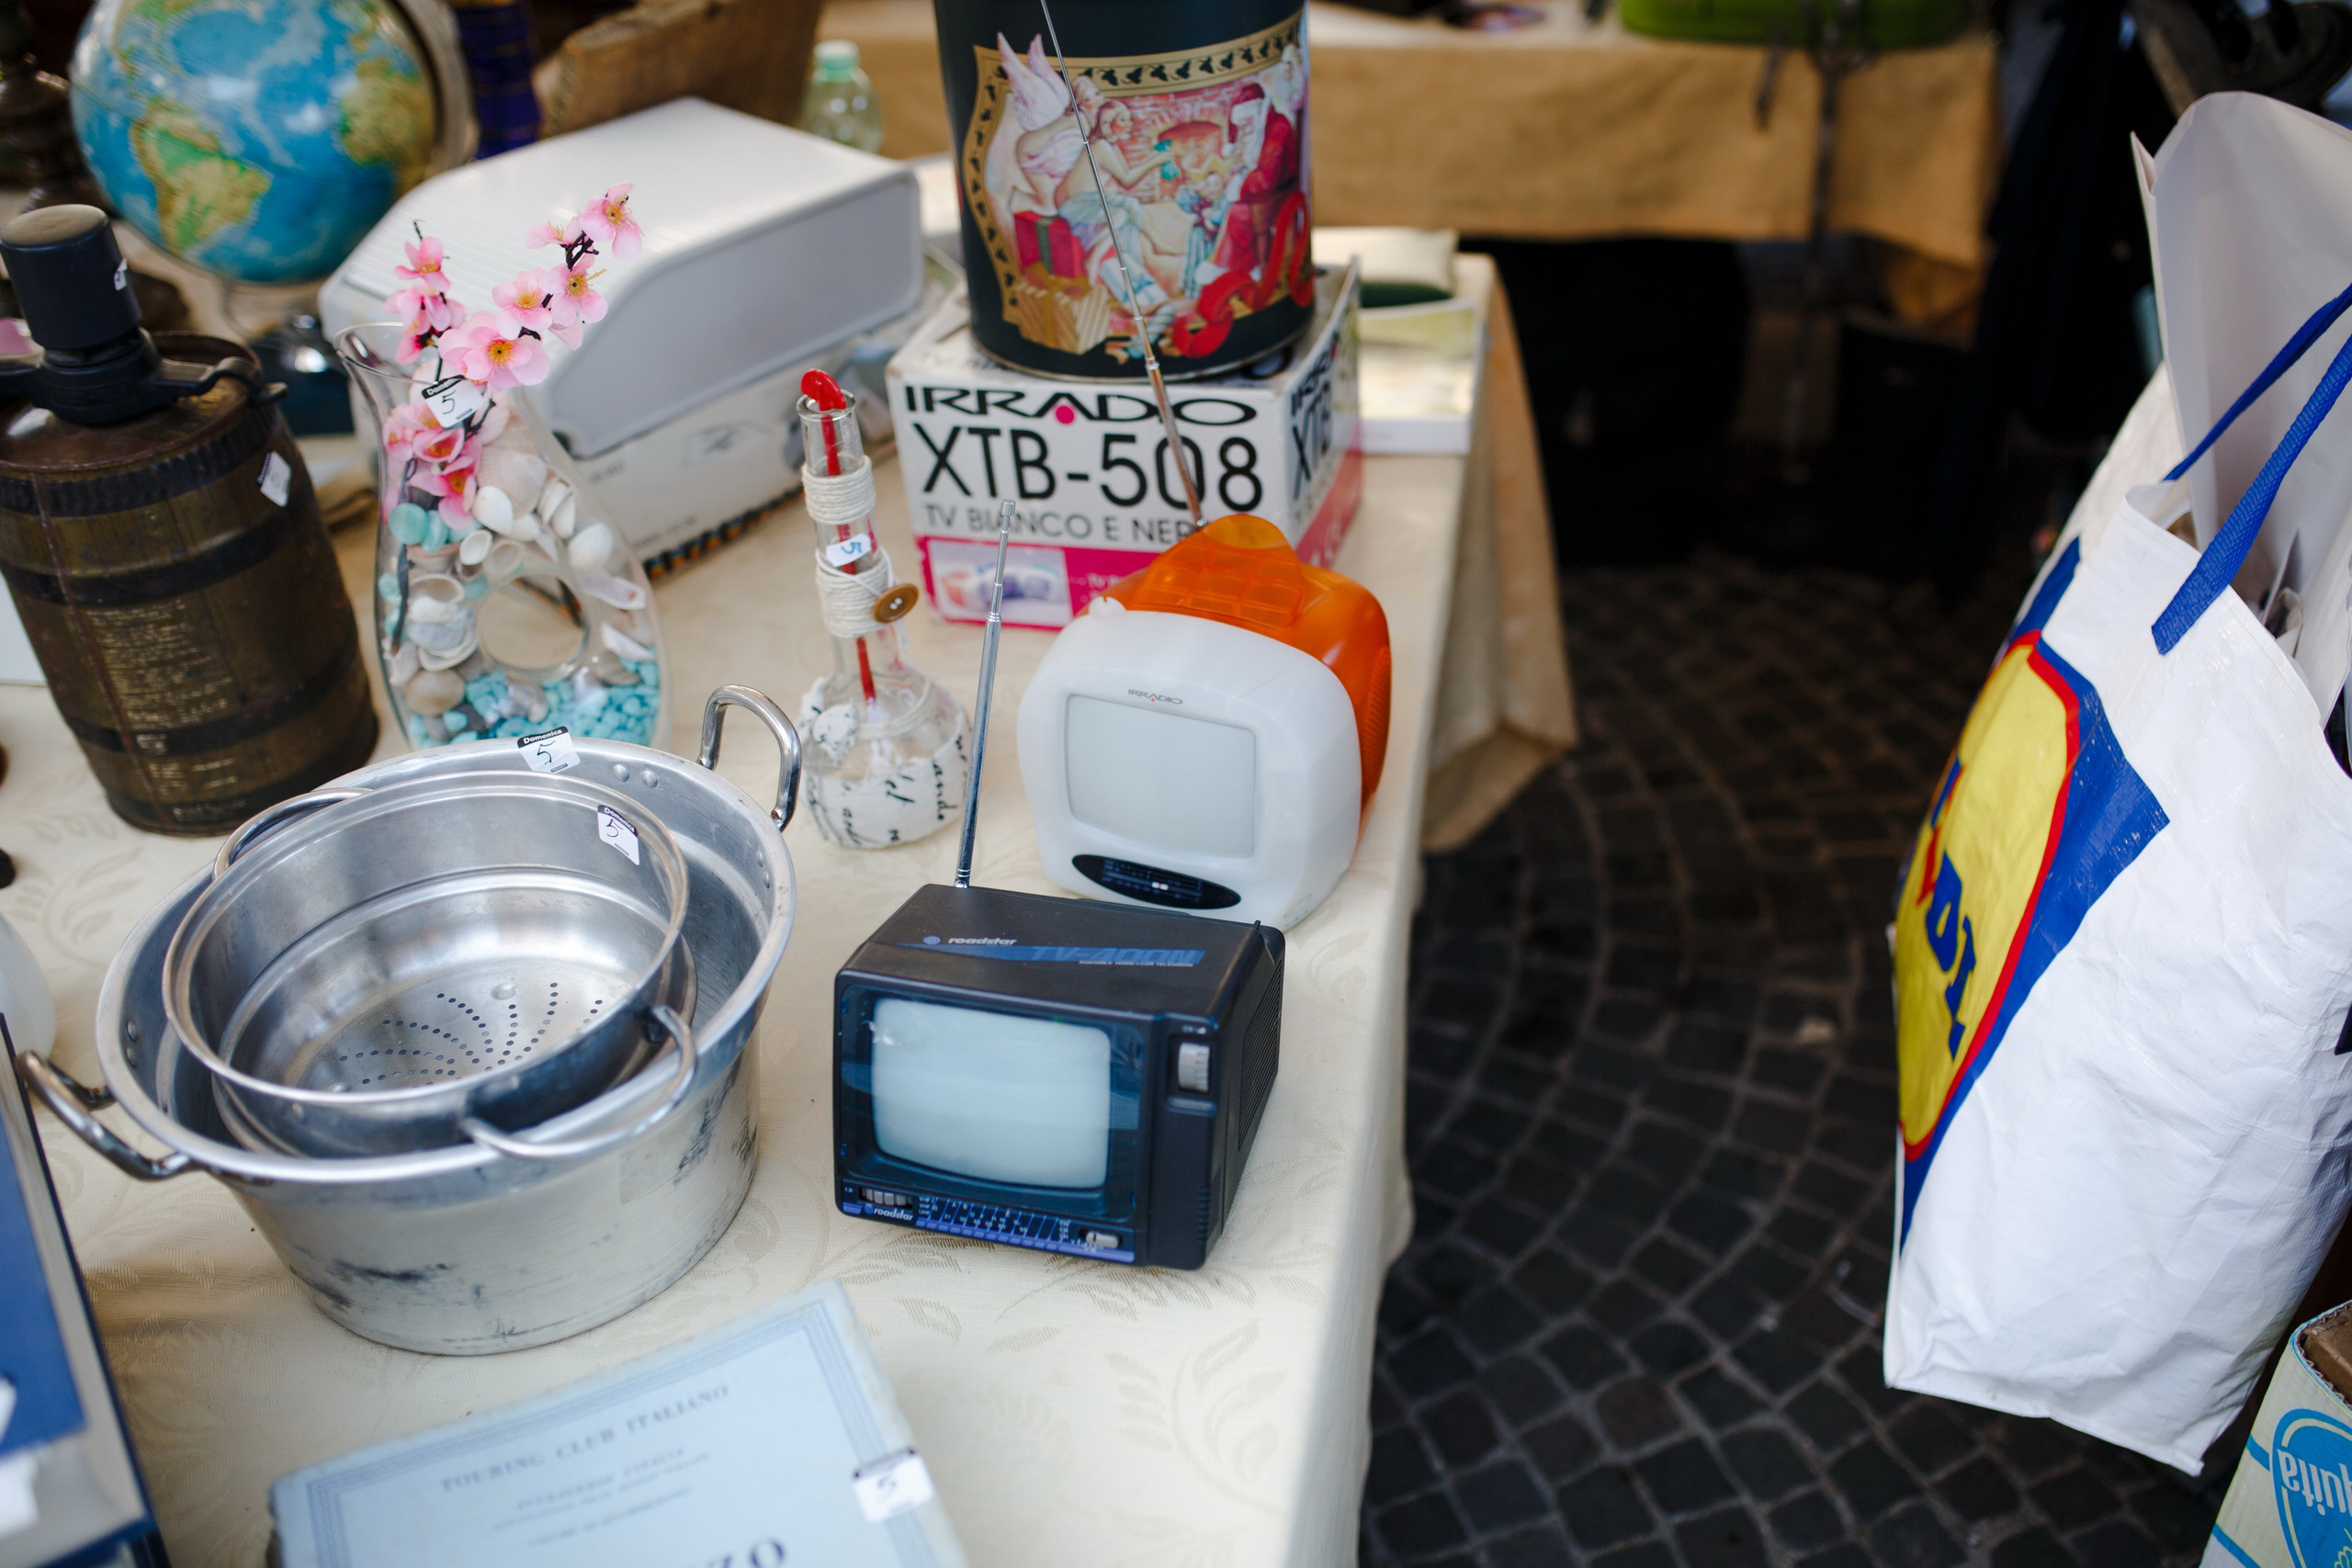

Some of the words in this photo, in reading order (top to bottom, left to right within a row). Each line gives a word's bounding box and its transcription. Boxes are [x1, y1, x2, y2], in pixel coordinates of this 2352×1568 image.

[441, 389, 458, 415] 5
[905, 385, 1258, 426] IRRADO
[913, 422, 1263, 513] XTB-508
[924, 504, 958, 528] TV
[1103, 515, 1120, 542] E
[1132, 518, 1199, 546] NER
[1127, 688, 1184, 705] IRRADIO
[522, 728, 563, 745] Domenica
[536, 739, 556, 765] 5
[603, 806, 636, 833] Domenica
[605, 818, 625, 838] 5
[947, 936, 1018, 946] roadstar
[874, 1206, 914, 1222] roadstar
[441, 1452, 547, 1493] TOURING
[555, 1427, 616, 1461] CLUB
[626, 1383, 729, 1433] ITALIANO
